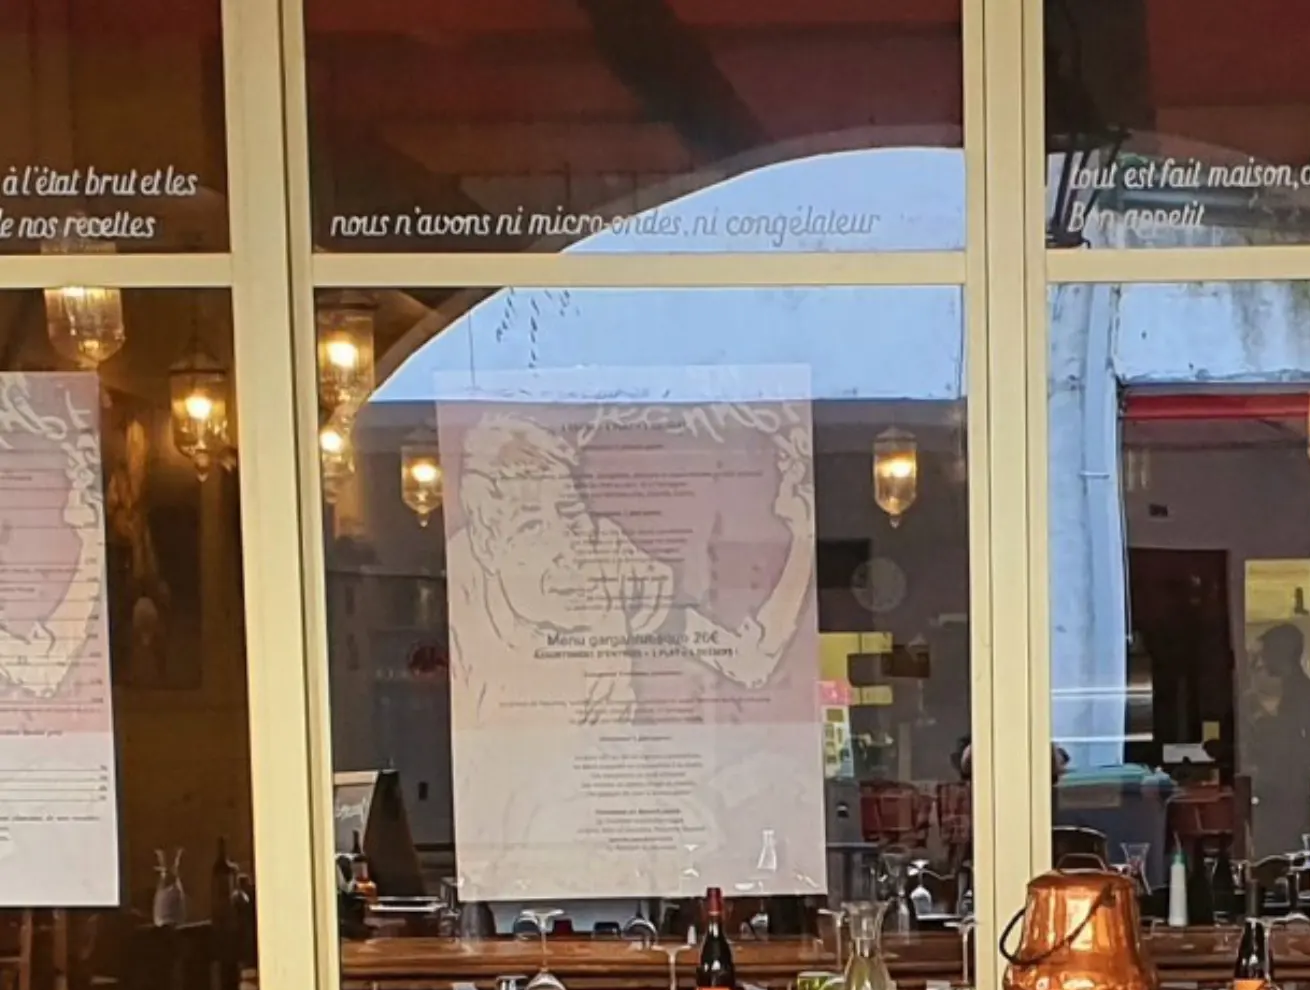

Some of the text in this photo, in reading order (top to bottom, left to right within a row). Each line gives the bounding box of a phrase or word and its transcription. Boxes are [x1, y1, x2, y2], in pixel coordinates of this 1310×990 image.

[85, 165, 138, 196] brut
[140, 168, 162, 196] et
[164, 164, 198, 196] les
[1123, 164, 1156, 188] est
[1158, 157, 1202, 189] fait
[18, 216, 58, 238] nos
[63, 211, 157, 238] recettes
[330, 214, 390, 236] nous
[496, 206, 523, 235] ni
[692, 208, 718, 236] ni
[725, 205, 881, 247] congélateur
